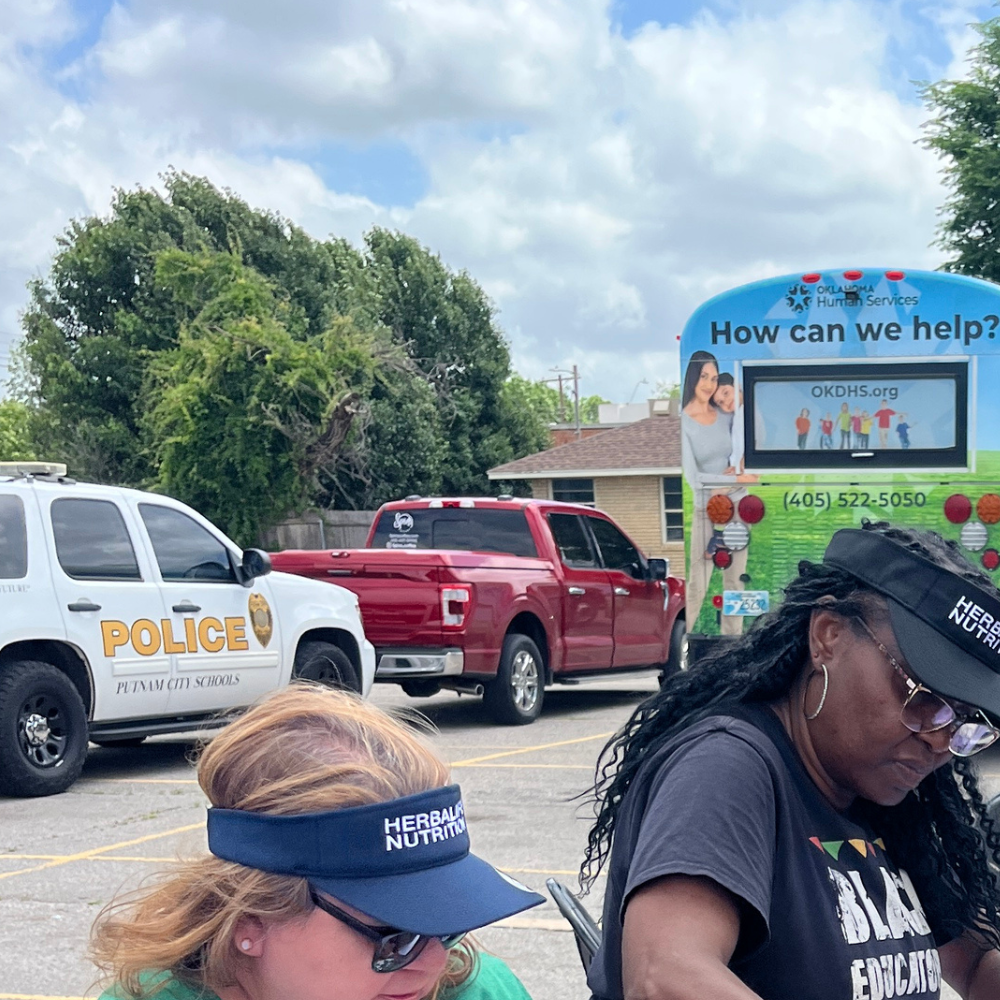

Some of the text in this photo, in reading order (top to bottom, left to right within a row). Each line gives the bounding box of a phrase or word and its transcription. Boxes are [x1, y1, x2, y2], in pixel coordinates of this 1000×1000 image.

[817, 293, 919, 308] Human Services
[710, 314, 1000, 346] How can we help?
[811, 384, 899, 400] OKDHS.org
[783, 491, 926, 511] (405) 522-5050
[100, 616, 249, 657] POLICE
[116, 673, 241, 695] PUTNAM CITY SCHOOLS
